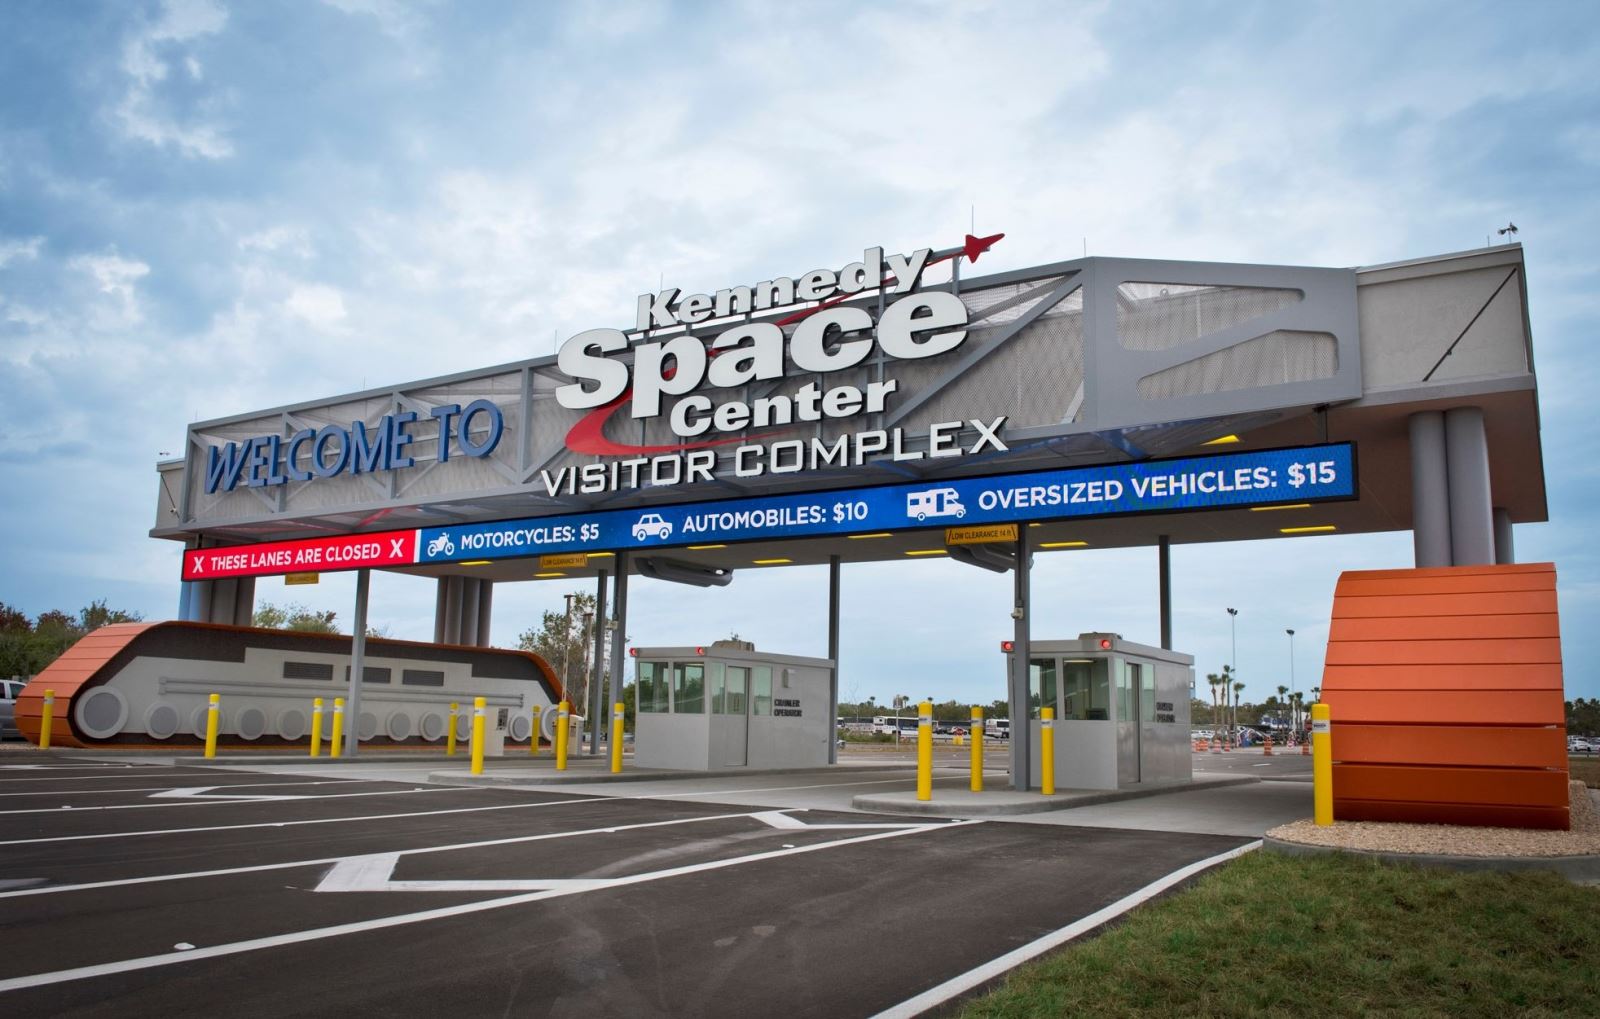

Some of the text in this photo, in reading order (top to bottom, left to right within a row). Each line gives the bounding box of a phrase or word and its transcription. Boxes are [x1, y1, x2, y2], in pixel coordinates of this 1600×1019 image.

[636, 246, 932, 330] Kennedy
[555, 291, 969, 419] Space
[669, 379, 899, 438] Center
[204, 398, 504, 494] WELCOME TO
[541, 416, 1010, 498] VISITOR COMPLEX
[978, 461, 1336, 511] OVERSIZED VEHICLES: $15
[461, 523, 599, 550] MOTORCYCLES: $5
[682, 501, 869, 533] AUTOMOBILES: $10
[951, 532, 964, 540] LOW
[965, 530, 998, 540] CLEARANCE
[210, 555, 248, 571] THESE
[250, 550, 292, 568] LANES
[294, 547, 322, 565] ARE
[325, 543, 381, 562] CLOSED
